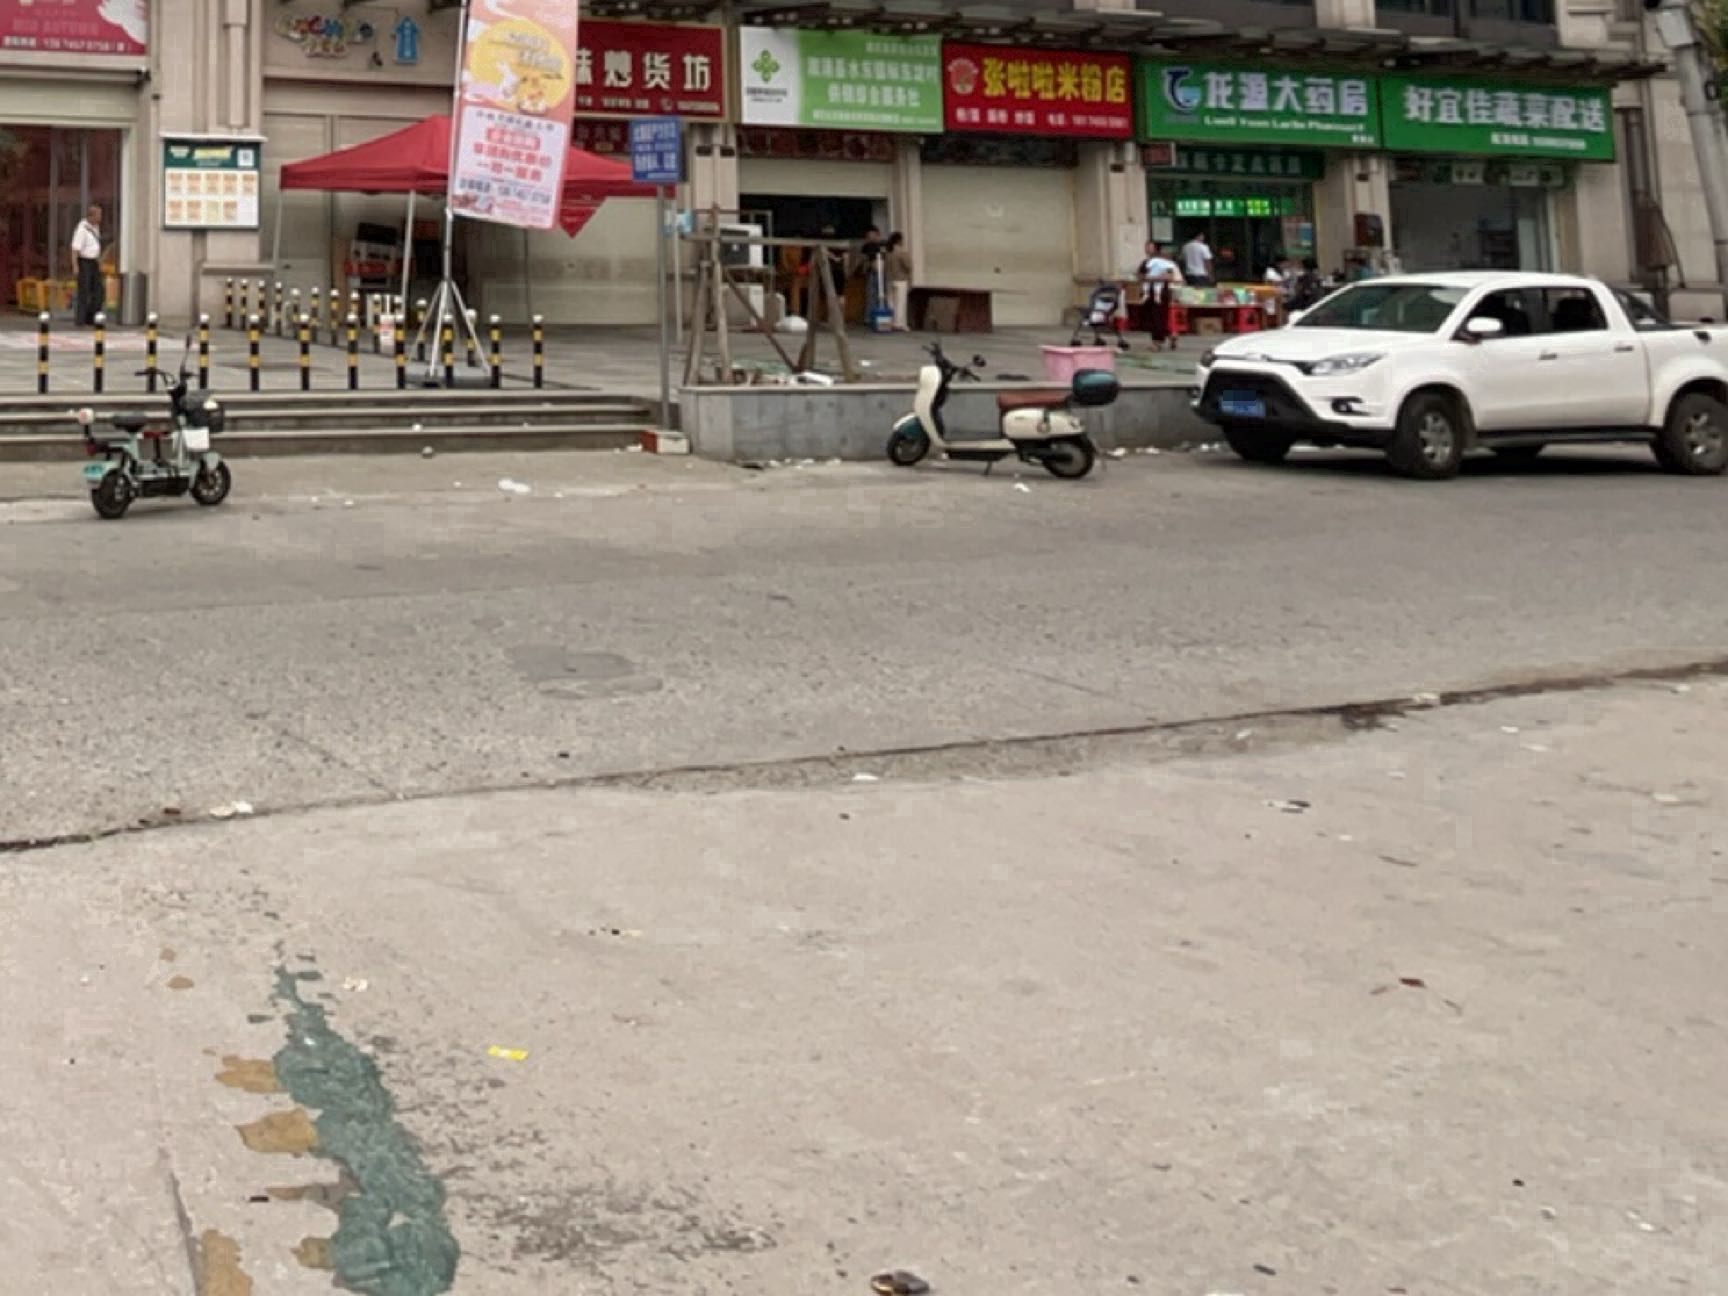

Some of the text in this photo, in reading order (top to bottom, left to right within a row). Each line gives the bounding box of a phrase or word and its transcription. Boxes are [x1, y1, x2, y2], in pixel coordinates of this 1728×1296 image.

[983, 57, 1126, 102] 张啦啦米粉店
[1404, 85, 1606, 132] 好宜佳蔬菜配送
